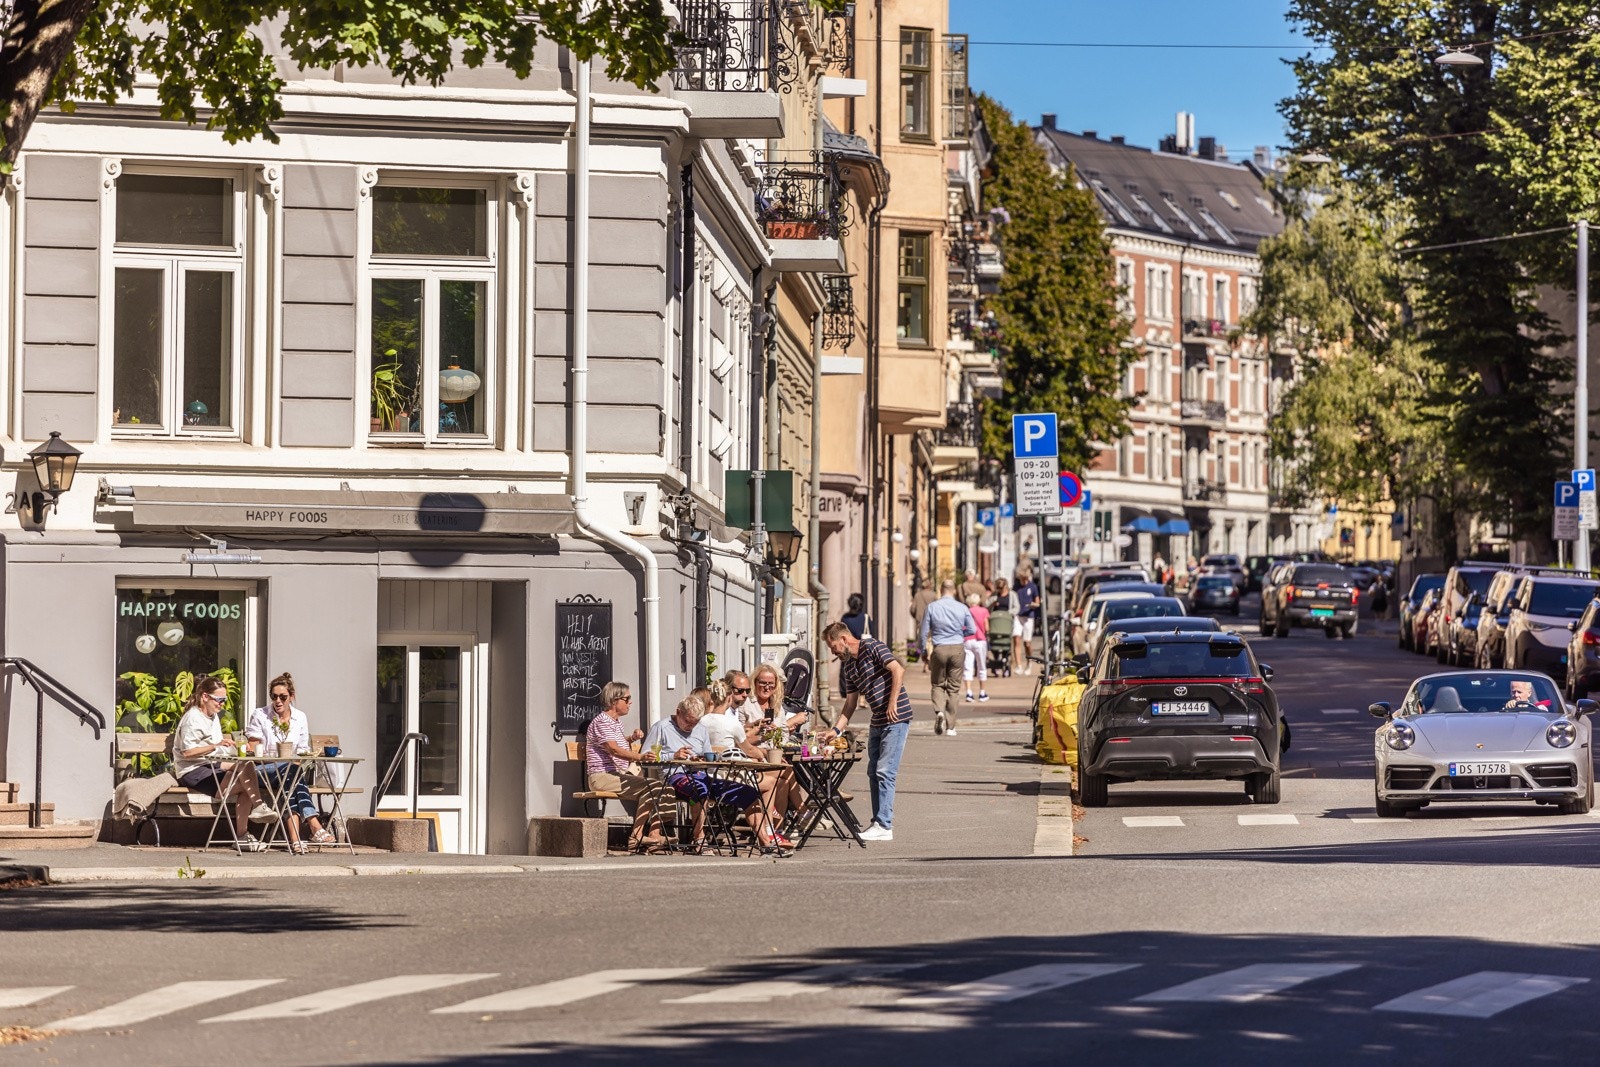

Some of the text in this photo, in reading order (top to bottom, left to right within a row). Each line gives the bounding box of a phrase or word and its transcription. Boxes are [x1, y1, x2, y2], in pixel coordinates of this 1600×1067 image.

[1024, 420, 1046, 452] P
[1561, 485, 1575, 504] P
[818, 496, 842, 512] arve
[246, 510, 328, 523] HAPPY FOODS
[120, 601, 241, 619] HAPPY FOODS
[1161, 702, 1206, 712] EJ 54446
[1459, 763, 1507, 774] DS 17578
